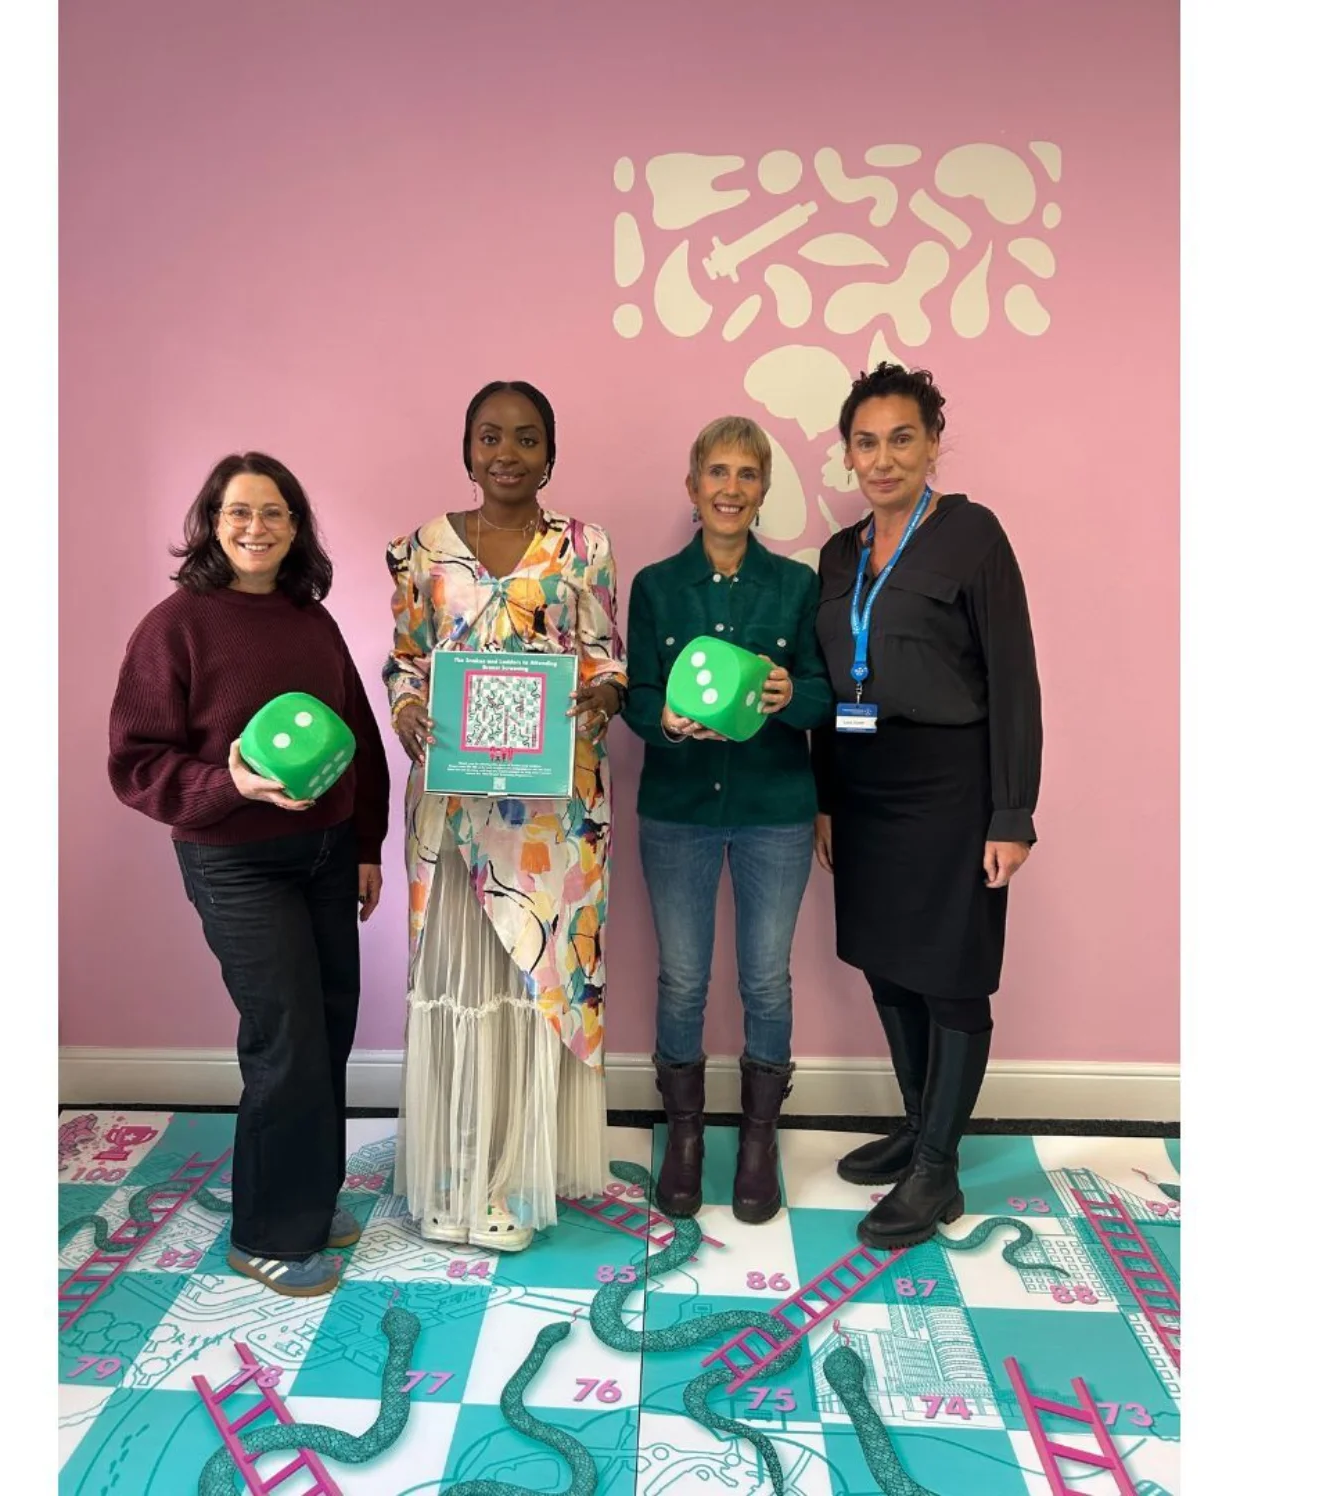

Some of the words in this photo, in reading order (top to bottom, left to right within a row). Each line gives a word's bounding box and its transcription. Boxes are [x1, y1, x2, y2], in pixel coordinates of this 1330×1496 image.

[71, 1167, 126, 1182] 100
[606, 1182, 645, 1198] 96
[1007, 1196, 1050, 1213] 93
[156, 1250, 202, 1268] 82
[446, 1260, 490, 1278] 84
[596, 1265, 637, 1283] 85
[746, 1271, 791, 1291] 86
[895, 1278, 938, 1297] 87
[1049, 1284, 1099, 1305] 88
[66, 1356, 122, 1380] 79
[229, 1363, 284, 1388] 78
[400, 1370, 454, 1395] 77
[573, 1378, 622, 1403] 76
[747, 1387, 798, 1412] 75
[920, 1396, 972, 1420] 74
[1095, 1402, 1155, 1428] 73
